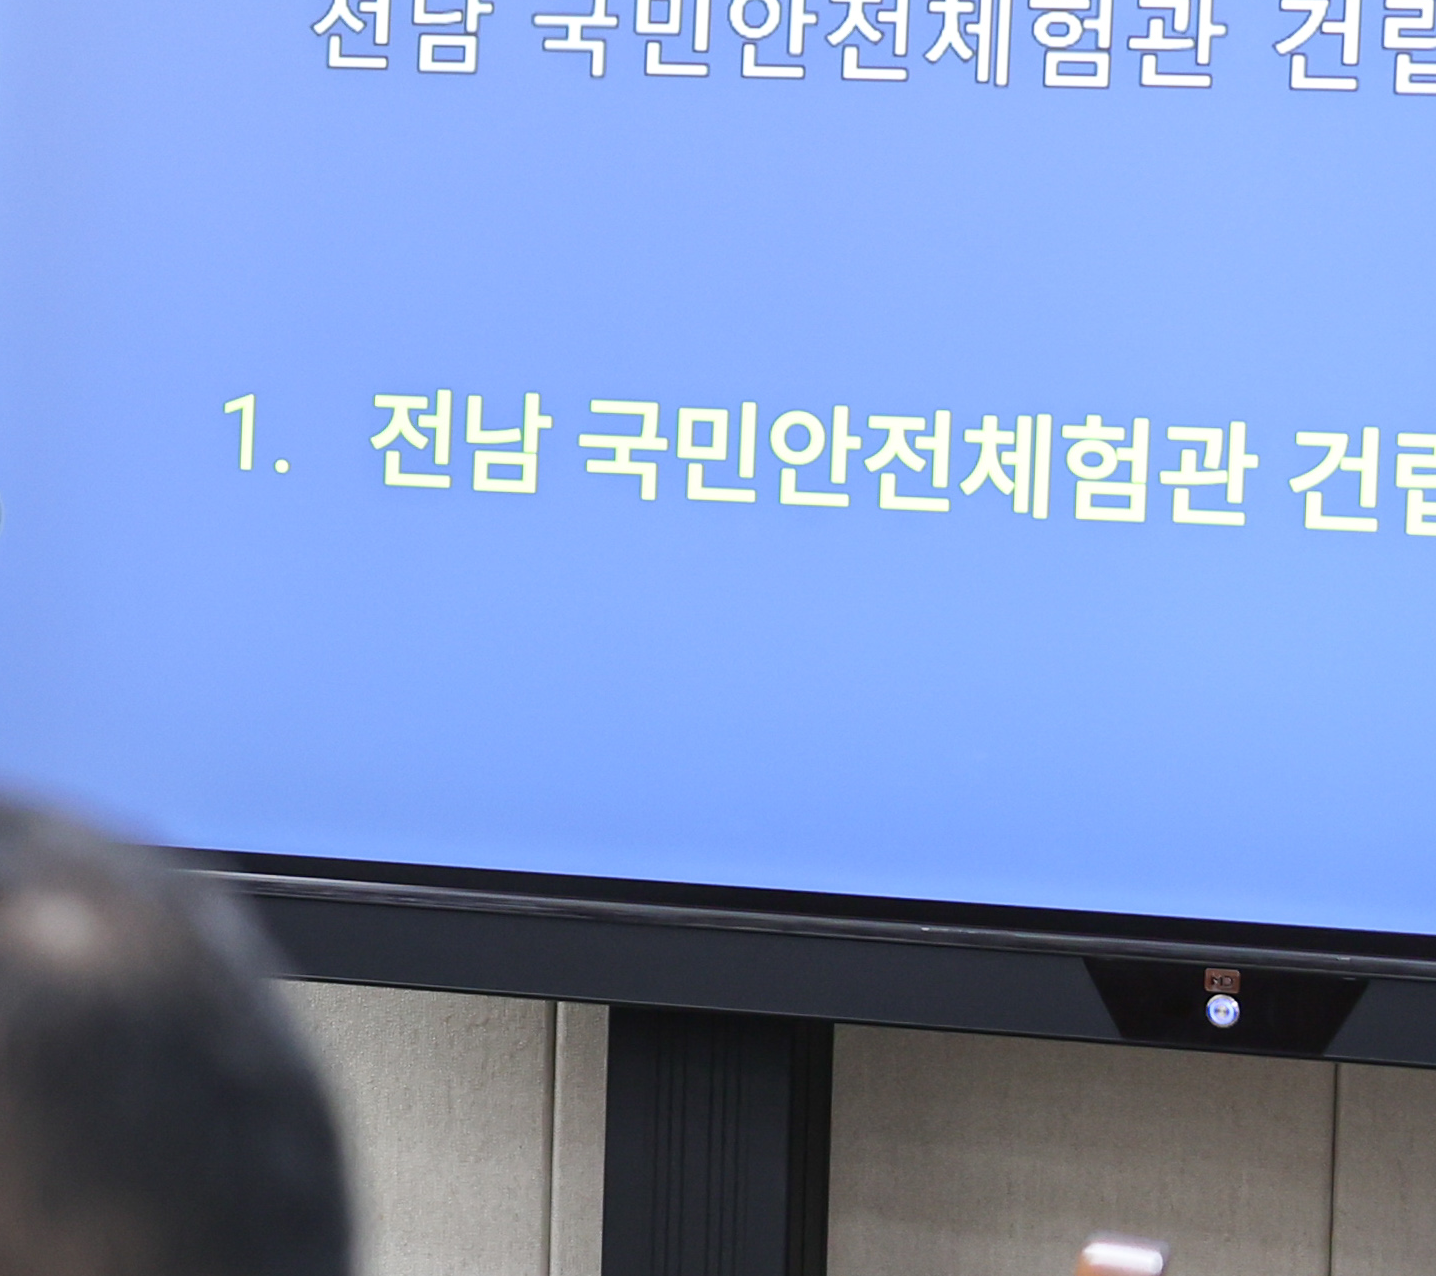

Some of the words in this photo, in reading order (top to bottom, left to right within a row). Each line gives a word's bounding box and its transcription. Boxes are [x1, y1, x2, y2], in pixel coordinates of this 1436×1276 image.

[223, 393, 290, 475] 1.
[369, 389, 554, 494] 전남
[577, 398, 1260, 527] 국민안전체험관
